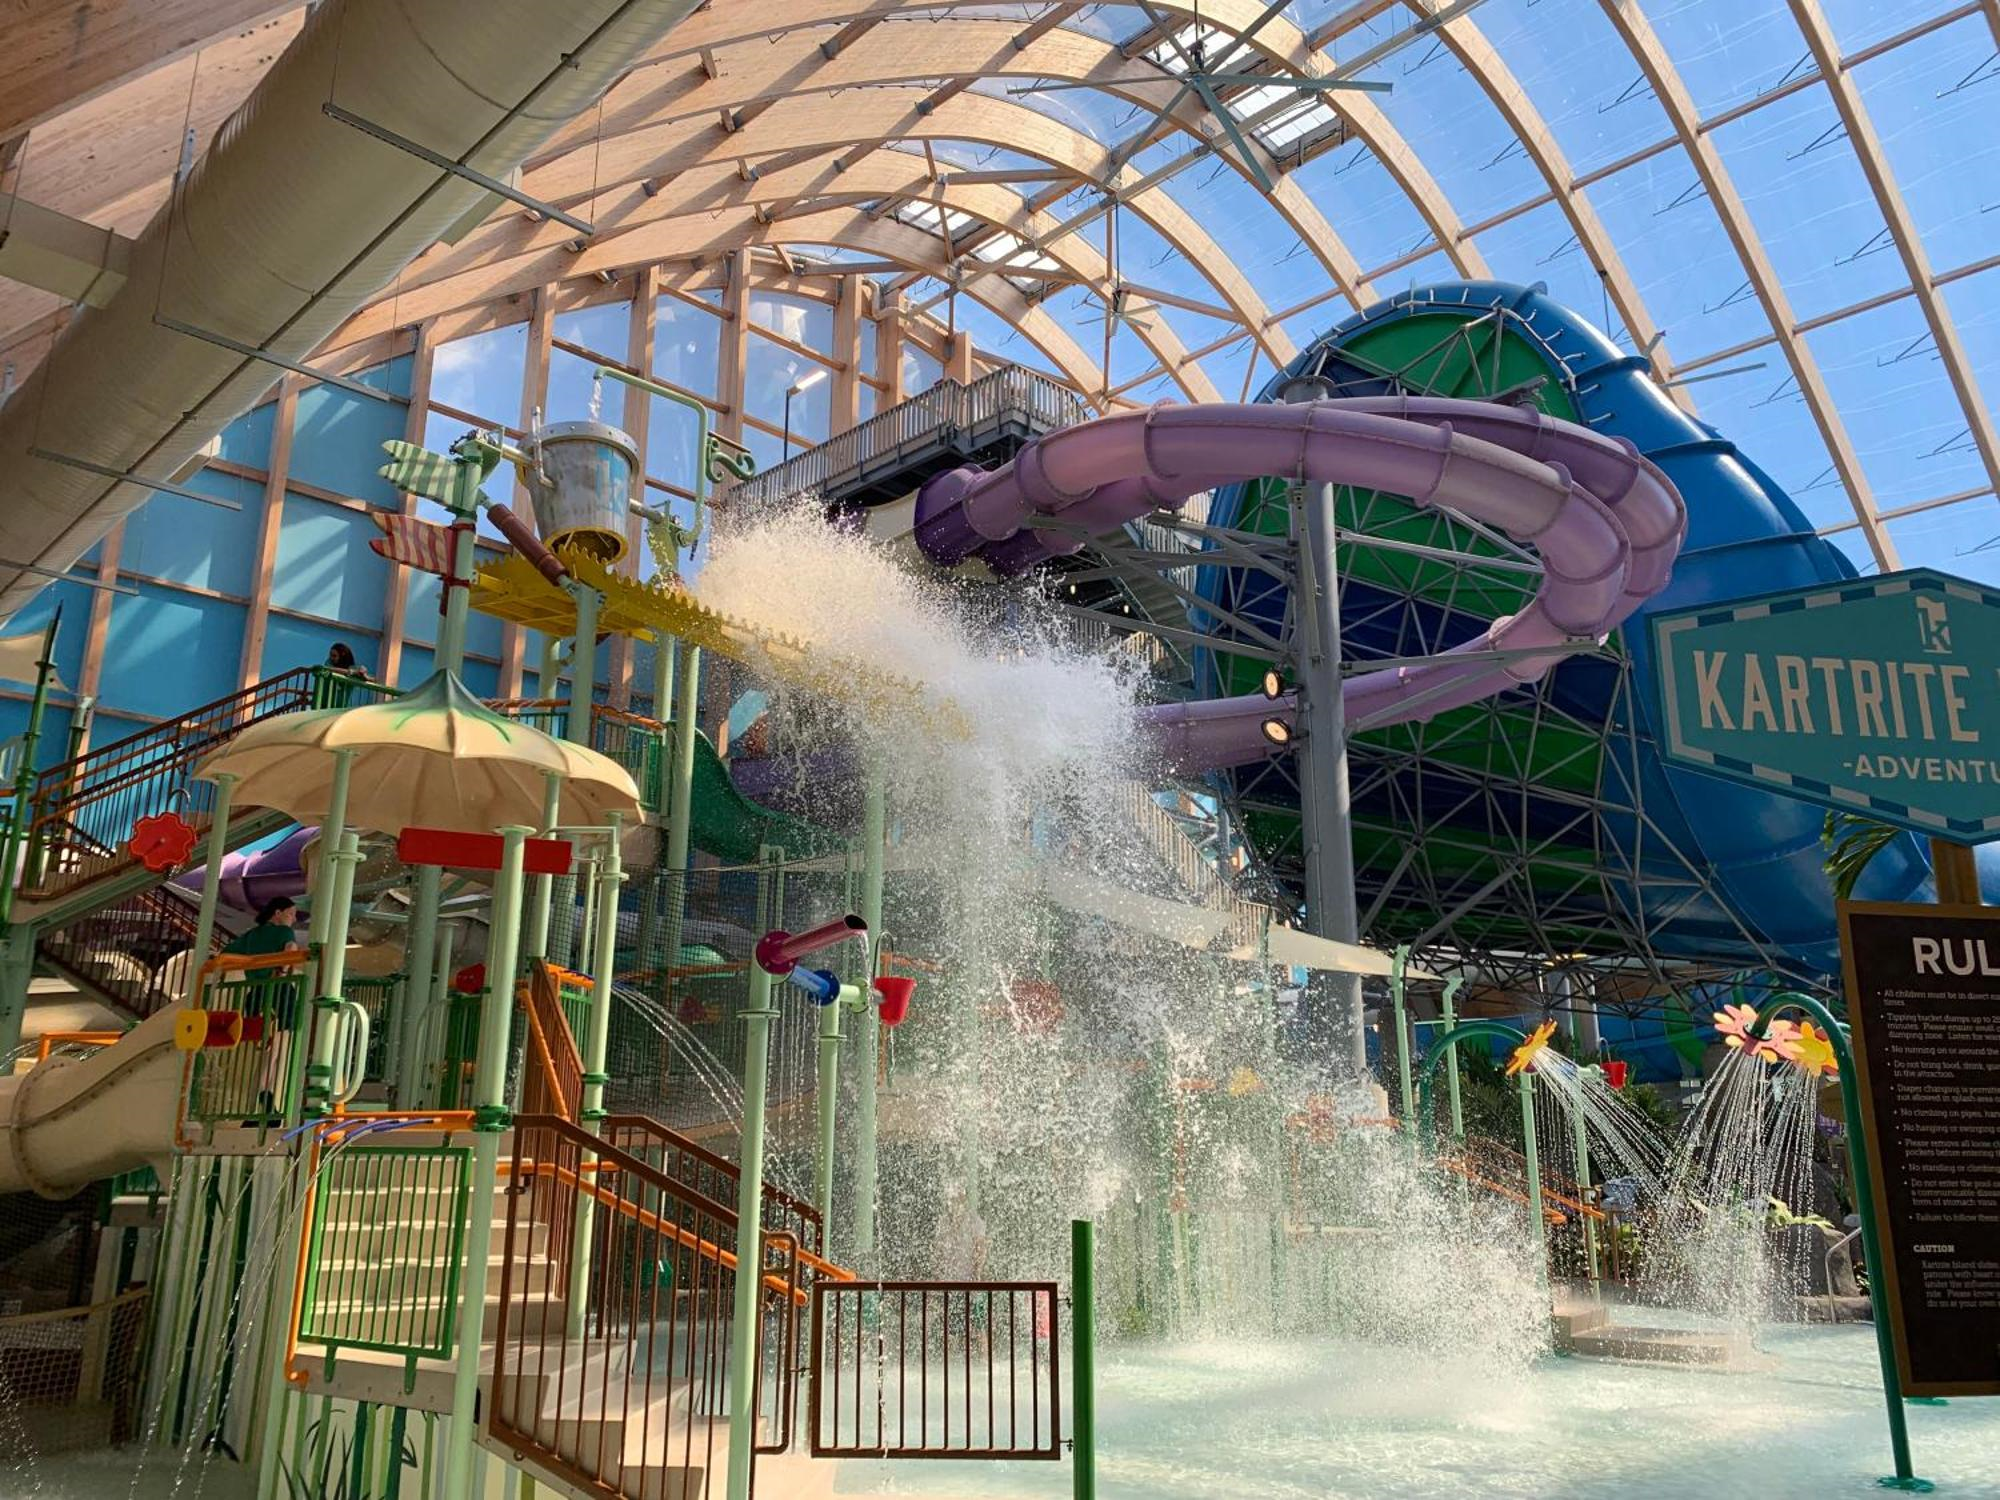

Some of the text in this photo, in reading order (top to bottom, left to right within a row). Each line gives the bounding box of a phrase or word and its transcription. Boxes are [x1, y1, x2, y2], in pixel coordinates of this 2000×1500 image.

[1693, 650, 1980, 742] KARTRITE
[1912, 937, 2000, 977] RUL
[1895, 990, 1926, 999] children
[1947, 991, 1957, 999] be
[1958, 992, 1967, 1000] in
[1886, 1012, 1917, 1023] Tipping
[1917, 1013, 1942, 1022] bucket
[1944, 1014, 1970, 1024] dumps
[1971, 1016, 1982, 1025] up
[1923, 1022, 1947, 1031] Please
[1948, 1024, 1973, 1032] ensure
[1888, 1031, 1924, 1041] dumping
[1947, 1031, 1971, 1040] Listen
[1971, 1032, 1983, 1041] for
[1891, 1045, 1903, 1053] No
[1904, 1047, 1936, 1056] running
[1936, 1047, 1947, 1055] on
[1958, 1047, 1986, 1056] around
[1986, 1048, 2000, 1056] the
[1894, 1059, 1905, 1069] Do
[1906, 1061, 1920, 1069] not
[1920, 1061, 1941, 1071] bring
[1896, 1083, 1922, 1093] Diaper
[1923, 1084, 1960, 1095] changing
[1896, 1094, 1910, 1102] not
[1911, 1093, 1941, 1102] allowed
[1941, 1095, 1950, 1103] in
[1951, 1094, 1977, 1104] splash
[1900, 1107, 1913, 1117] No
[1902, 1123, 1914, 1132] No
[1915, 1123, 1949, 1134] hanging
[1959, 1125, 1996, 1134] swinging
[1904, 1138, 1929, 1148] Please
[1930, 1140, 1960, 1148] remove
[1961, 1139, 1970, 1148] all
[1970, 1140, 1991, 1148] loose
[1904, 1148, 1935, 1159] pockets
[1935, 1148, 1961, 1157] before
[1961, 1150, 1995, 1160] entering
[1908, 1162, 1921, 1172] No
[1921, 1163, 1956, 1174] standing
[1911, 1177, 1923, 1188] Do
[1923, 1180, 1937, 1188] not
[1938, 1180, 1959, 1188] enter
[1959, 1179, 1973, 1188] the
[1912, 1197, 1932, 1206] form
[1932, 1197, 1941, 1206] of
[1942, 1198, 1977, 1207] stomach
[1915, 1212, 1943, 1222] Failure
[1943, 1213, 1953, 1221] to
[1953, 1213, 1977, 1222] follow
[1912, 1244, 1955, 1253] CAUTION
[1923, 1271, 1953, 1281] patrons
[1953, 1270, 1972, 1279] with
[1972, 1271, 1993, 1279] heart
[1924, 1280, 1948, 1289] under
[1948, 1280, 1963, 1289] the
[1946, 1288, 1972, 1298] Please
[1927, 1298, 1938, 1308] do
[1958, 1300, 1977, 1310] your
